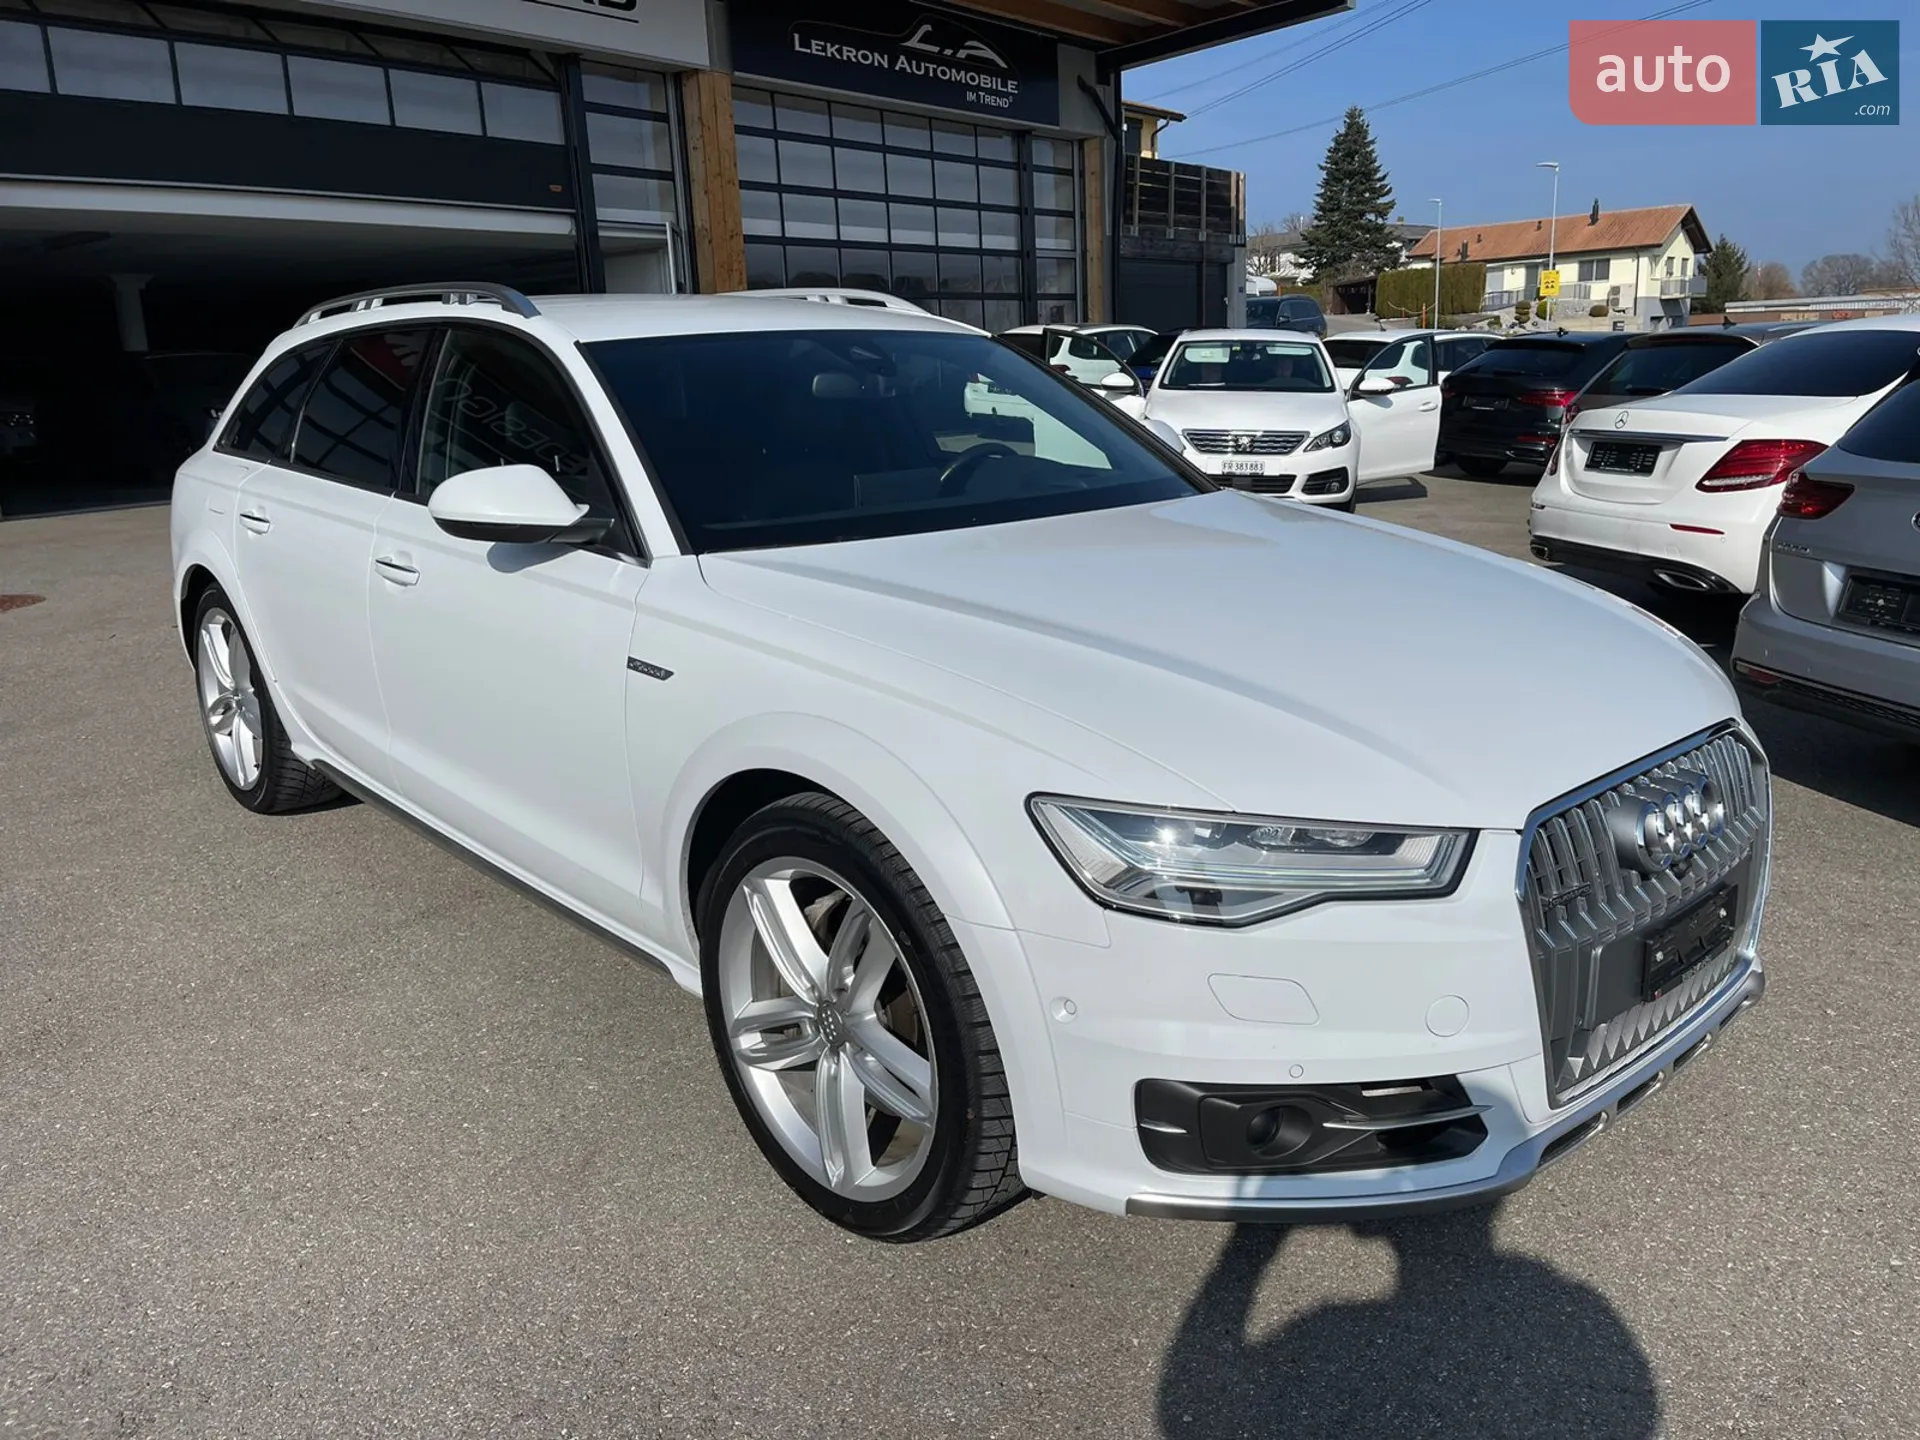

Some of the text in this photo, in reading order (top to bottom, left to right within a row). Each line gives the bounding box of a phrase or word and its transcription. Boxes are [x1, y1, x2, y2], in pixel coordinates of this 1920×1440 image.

[793, 33, 1018, 94] LEKRON AUTOMOBILE
[966, 91, 977, 102] IM
[1223, 462, 1233, 470] FR
